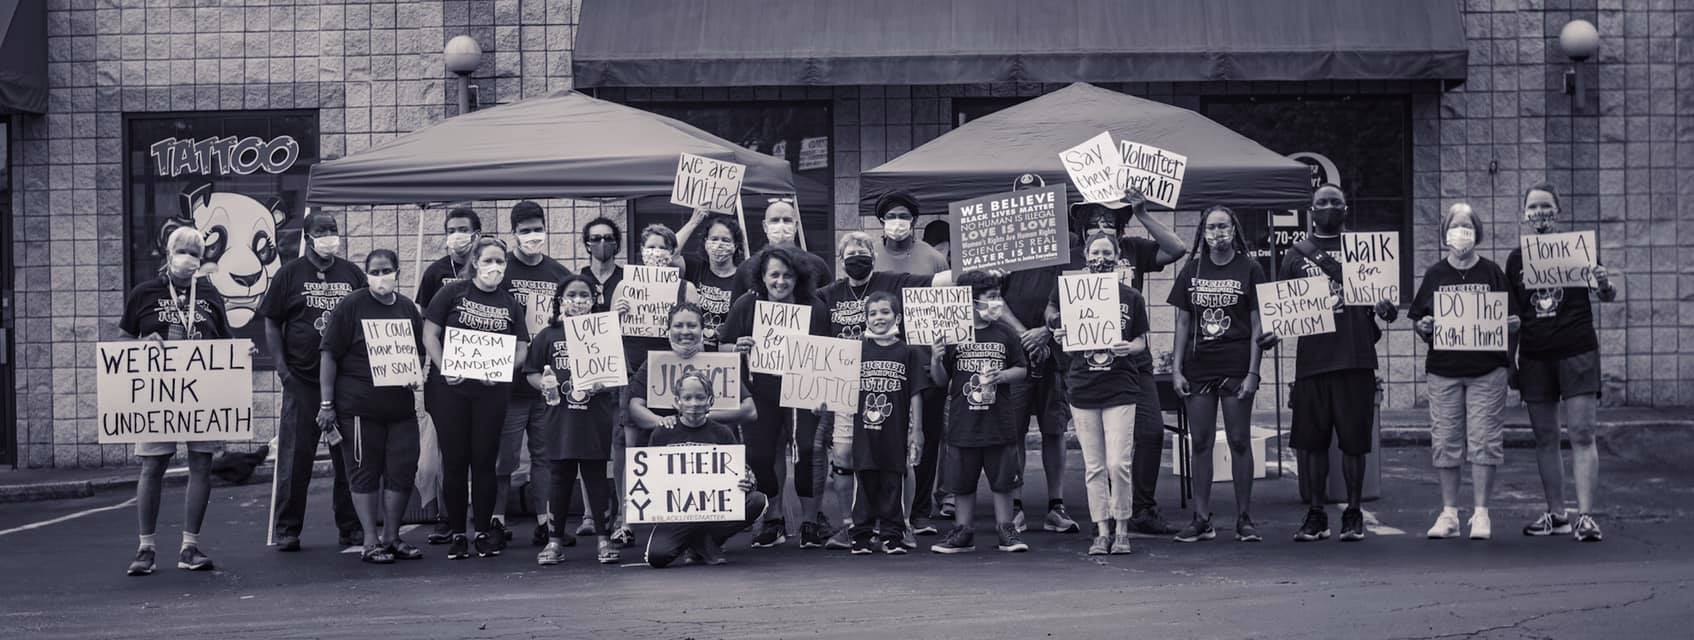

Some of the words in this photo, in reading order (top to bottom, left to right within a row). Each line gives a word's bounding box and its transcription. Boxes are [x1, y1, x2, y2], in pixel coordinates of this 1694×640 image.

[150, 135, 300, 177] TATTOO
[1121, 142, 1184, 178] Volunteer
[709, 161, 738, 180] are
[1156, 176, 1174, 203] in
[960, 203, 984, 217] WE
[991, 191, 1055, 211] BELIEVE
[960, 213, 988, 225] BLACK
[991, 209, 1016, 218] LIVES
[1019, 203, 1055, 214] MATTER
[960, 222, 976, 232] NO
[978, 216, 1012, 229] HUMAN
[1015, 214, 1023, 223] IS
[1024, 210, 1055, 220] ILLEGAL
[961, 227, 996, 242] LOVE
[1001, 223, 1015, 235] IS
[1020, 218, 1056, 232] LOVE
[961, 242, 1009, 258] SCIENCE
[1015, 240, 1025, 249] IS
[1030, 235, 1057, 246] REAL
[962, 252, 1005, 266] WATER
[1011, 248, 1024, 258] IS
[1030, 243, 1058, 255] LIFE
[1342, 234, 1394, 263] Walk
[1526, 236, 1570, 260] Honk
[632, 266, 650, 283] All
[1527, 263, 1592, 286] Justice
[904, 288, 944, 305] RACISM
[1064, 276, 1113, 305] LOVE
[1275, 279, 1310, 300] END
[1346, 277, 1398, 304] Justice
[936, 304, 972, 321] WORSE
[571, 315, 609, 342] LOVE
[906, 325, 973, 345] FILMED!
[1271, 313, 1325, 337] RACISM
[1434, 324, 1466, 347] Right
[448, 329, 504, 349] RACISM
[584, 341, 601, 355] is
[101, 344, 178, 375] WE'RE
[186, 344, 245, 371] ALL
[443, 354, 513, 371] PANDEMIC
[454, 346, 465, 358] IS
[471, 348, 482, 358] A
[751, 345, 785, 371] Justi
[785, 335, 836, 372] WALK
[372, 363, 387, 378] my
[575, 354, 618, 379] LOVE
[957, 358, 1004, 374] JUSTCE
[131, 377, 200, 404] PINK
[651, 362, 736, 399] JUICE
[783, 371, 860, 408] JUSTICE
[102, 407, 252, 437] UNDERNEATH
[659, 447, 739, 476] THEIR
[629, 450, 652, 521] SAY
[665, 488, 733, 513] NAME
